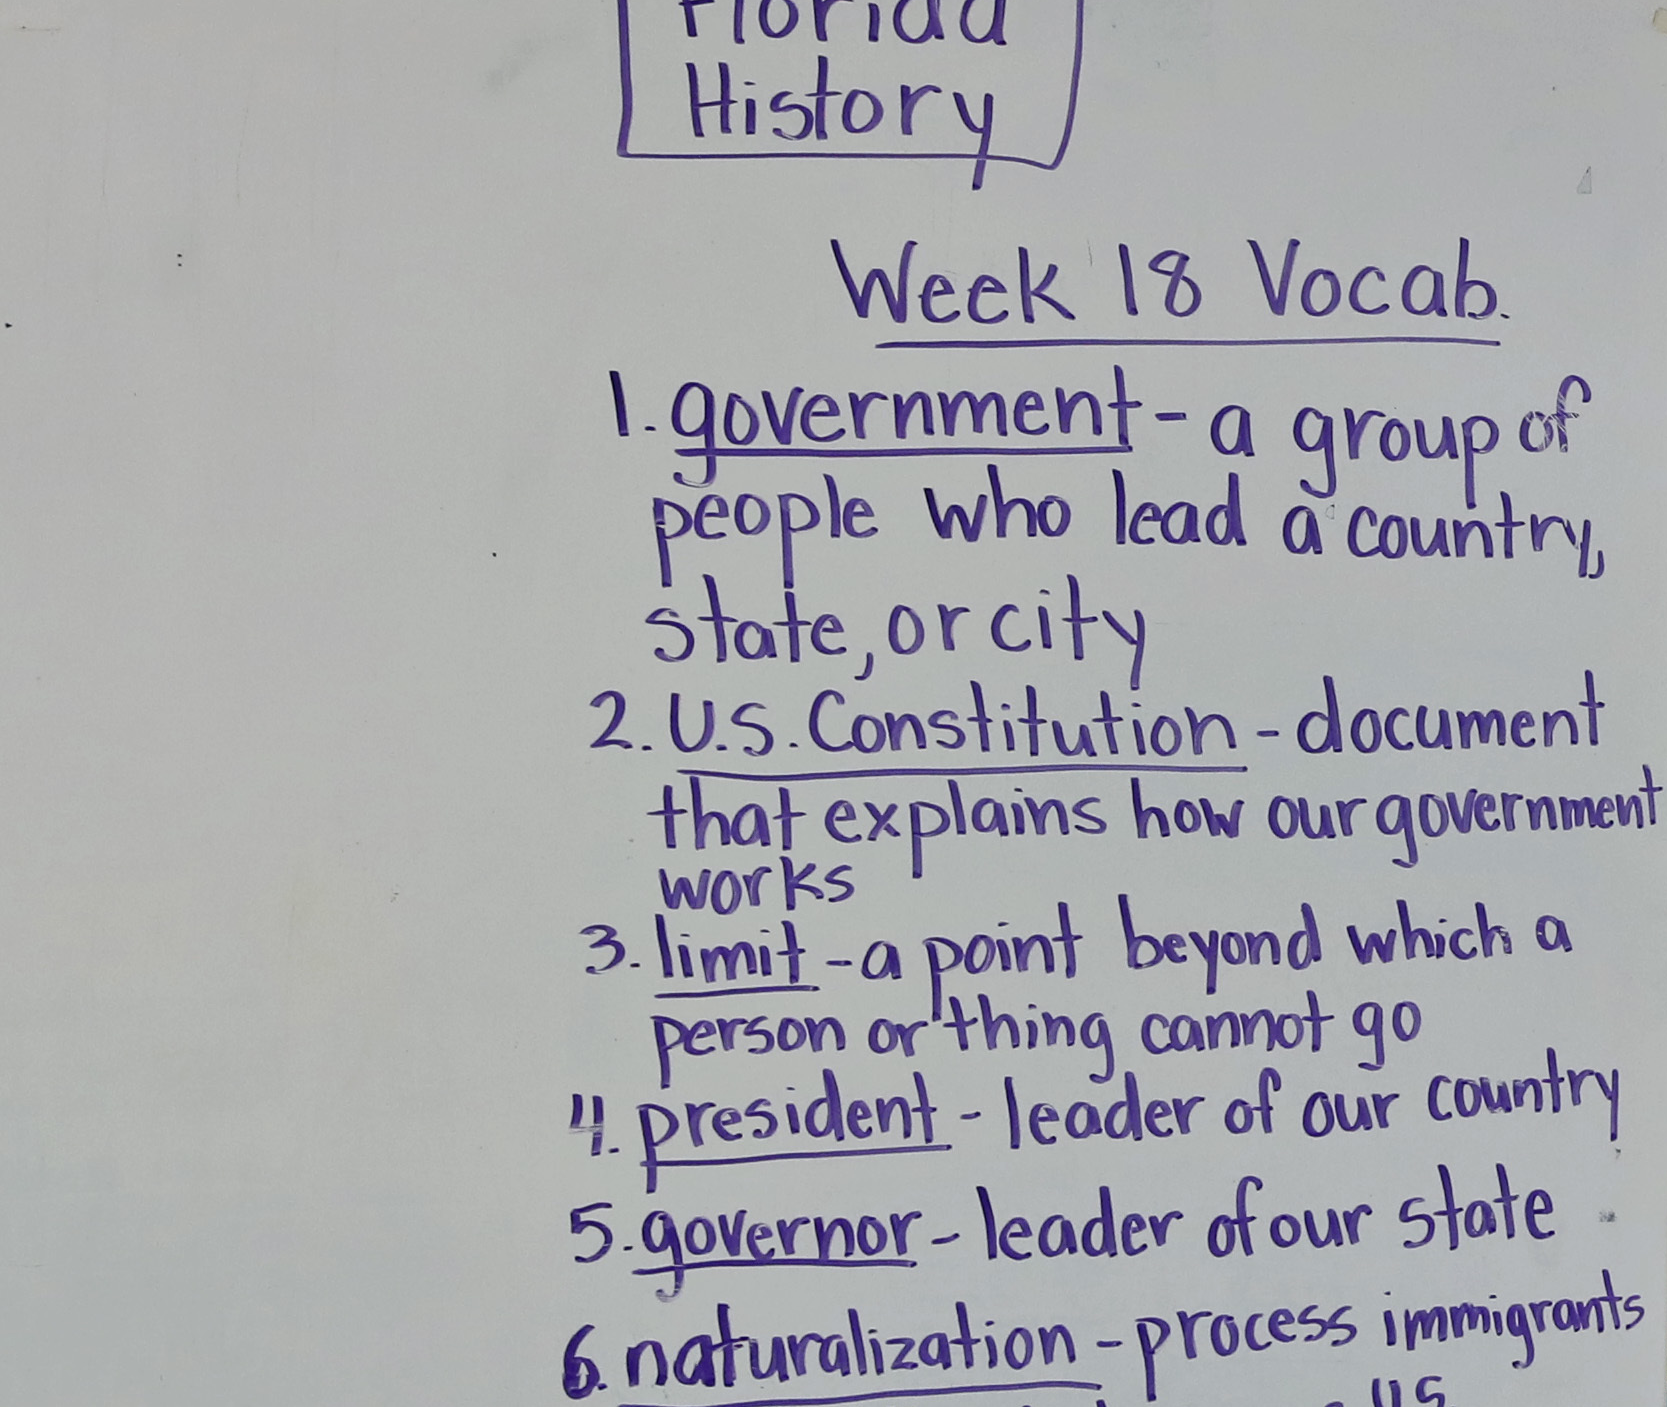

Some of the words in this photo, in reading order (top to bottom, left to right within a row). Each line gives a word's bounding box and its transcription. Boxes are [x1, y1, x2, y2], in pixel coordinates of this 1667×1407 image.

[684, 60, 997, 190] History
[829, 238, 1077, 326] Week
[1117, 242, 1203, 319] 18
[1246, 236, 1510, 320] Vocab.
[608, 369, 657, 438] 1.
[671, 362, 1144, 485] government
[1209, 403, 1256, 458] a
[1292, 405, 1501, 511] group
[1515, 371, 1594, 458] of
[652, 471, 880, 591] people
[922, 462, 1073, 544] who
[1111, 468, 1249, 548] lead
[1281, 504, 1325, 556] a
[1346, 490, 1607, 580] country,
[644, 573, 875, 682] state,
[887, 602, 971, 656] or
[989, 573, 1147, 692] city
[589, 688, 653, 752] 2.
[1296, 668, 1606, 755] document
[647, 784, 807, 852] that
[823, 778, 1109, 880] explains
[1129, 776, 1246, 840] how
[1267, 794, 1368, 840] our
[1374, 763, 1664, 870] government
[658, 854, 857, 916] works
[580, 923, 641, 976] 3.
[652, 918, 810, 984] limit
[860, 939, 904, 981] a
[922, 898, 1087, 1025] point
[1117, 892, 1324, 996] beyond
[1345, 898, 1514, 966] which
[1534, 914, 1574, 954] a
[649, 1010, 849, 1091] person
[864, 1008, 926, 1057] or
[930, 995, 1115, 1081] thing
[1140, 988, 1336, 1056] cannot
[1351, 999, 1424, 1072] go
[569, 1092, 621, 1158] 4.
[636, 1068, 939, 1194] president
[1003, 1069, 1206, 1151] leader
[1223, 1065, 1283, 1135] of
[1301, 1090, 1401, 1139] our
[1426, 1046, 1621, 1143] country
[569, 1200, 634, 1264] 5.
[634, 1203, 921, 1303] governor
[975, 1184, 1186, 1262] leader
[1204, 1179, 1271, 1259] of
[1269, 1196, 1376, 1248] our
[1398, 1162, 1557, 1252] state
[561, 1322, 609, 1401] 6.
[621, 1301, 1082, 1391] naturalization
[1135, 1303, 1359, 1403] process
[1382, 1267, 1647, 1370] immigrants
